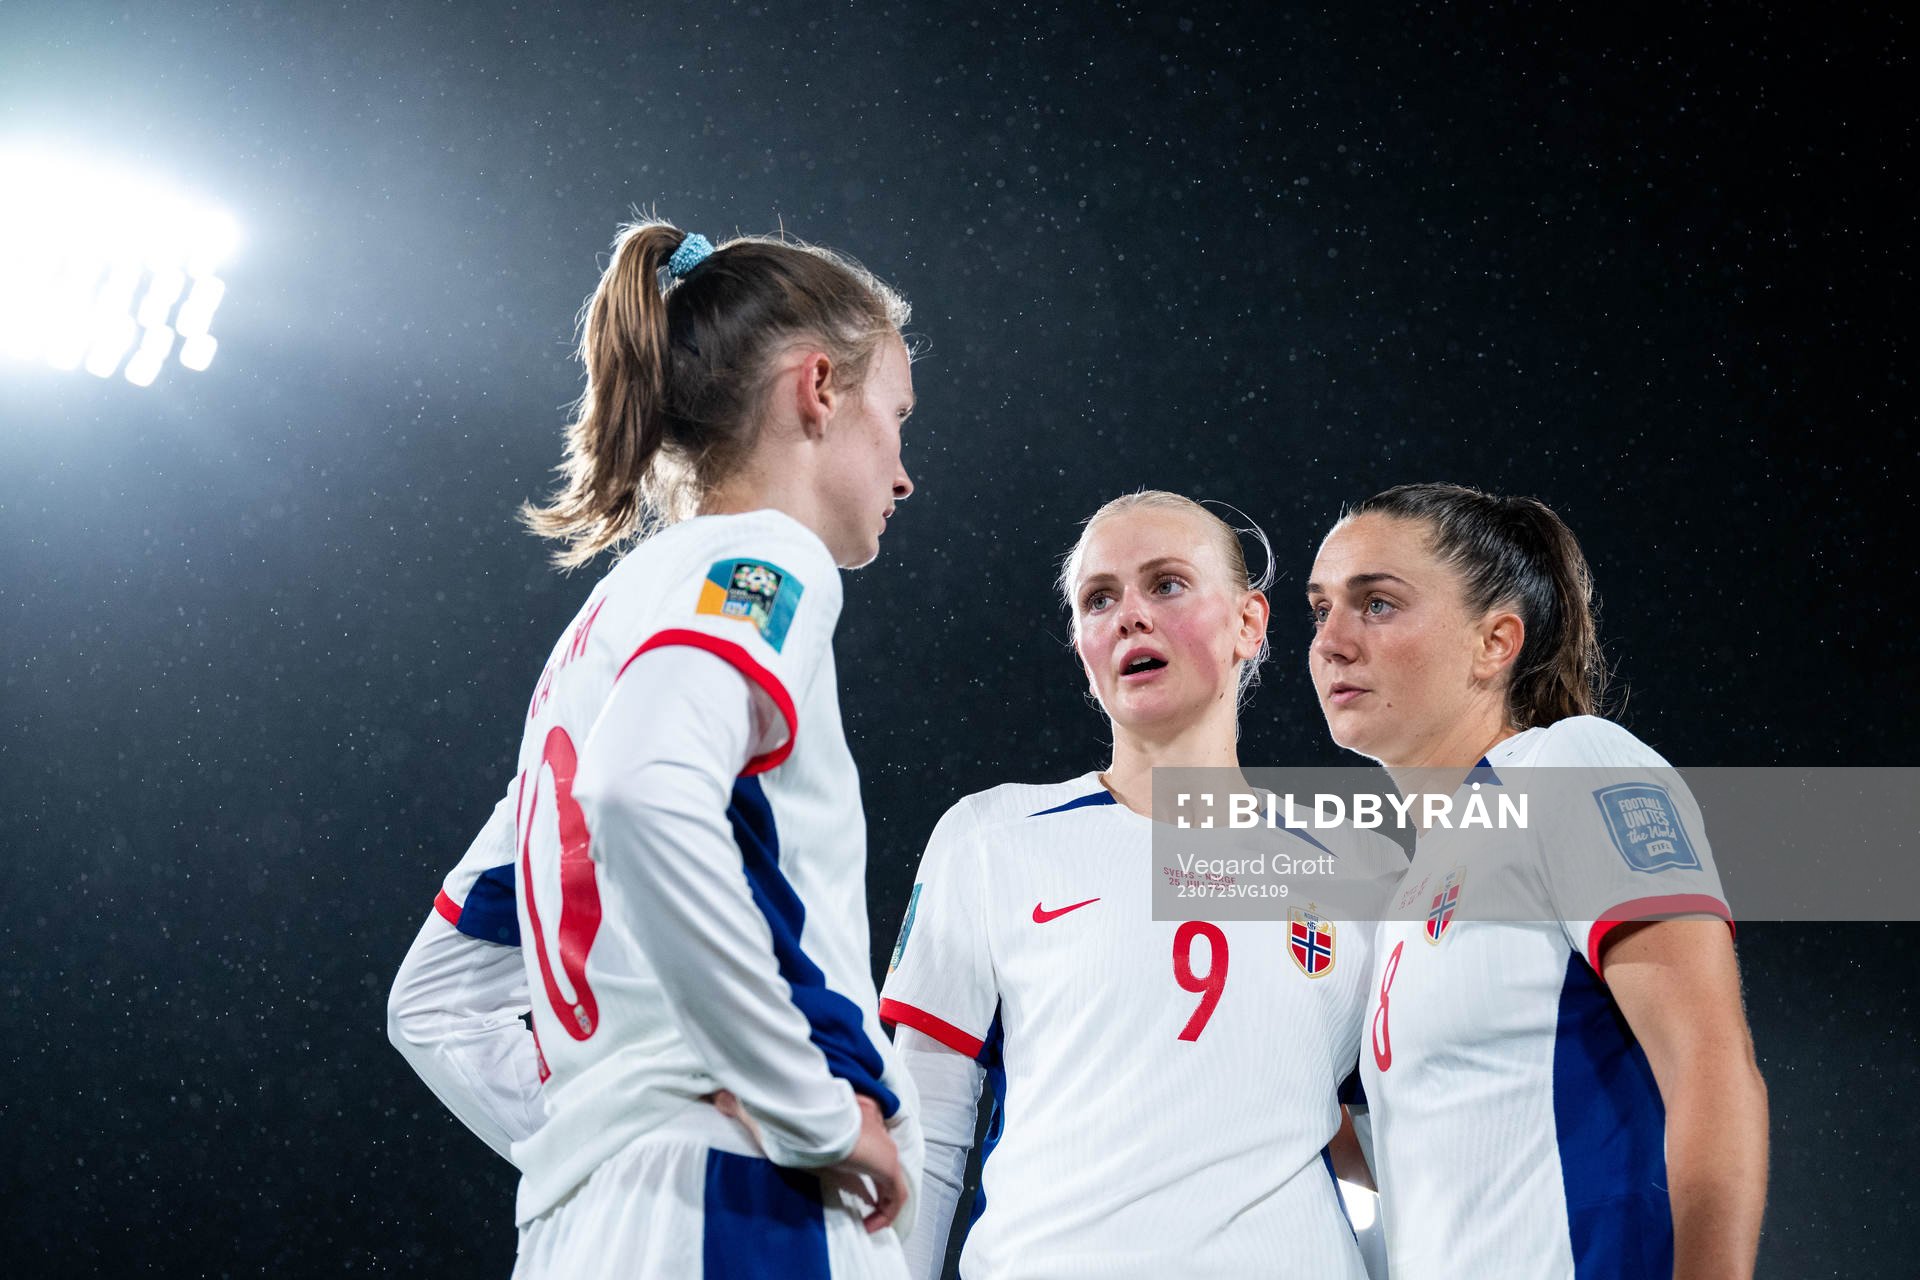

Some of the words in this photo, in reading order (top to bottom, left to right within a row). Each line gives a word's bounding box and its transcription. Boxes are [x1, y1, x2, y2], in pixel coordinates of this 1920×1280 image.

[1618, 797, 1664, 812] FOOTBALL
[1622, 809, 1669, 829] UNITES
[1627, 829, 1649, 844] the
[1172, 920, 1230, 1042] 9
[1372, 940, 1404, 1073] 8
